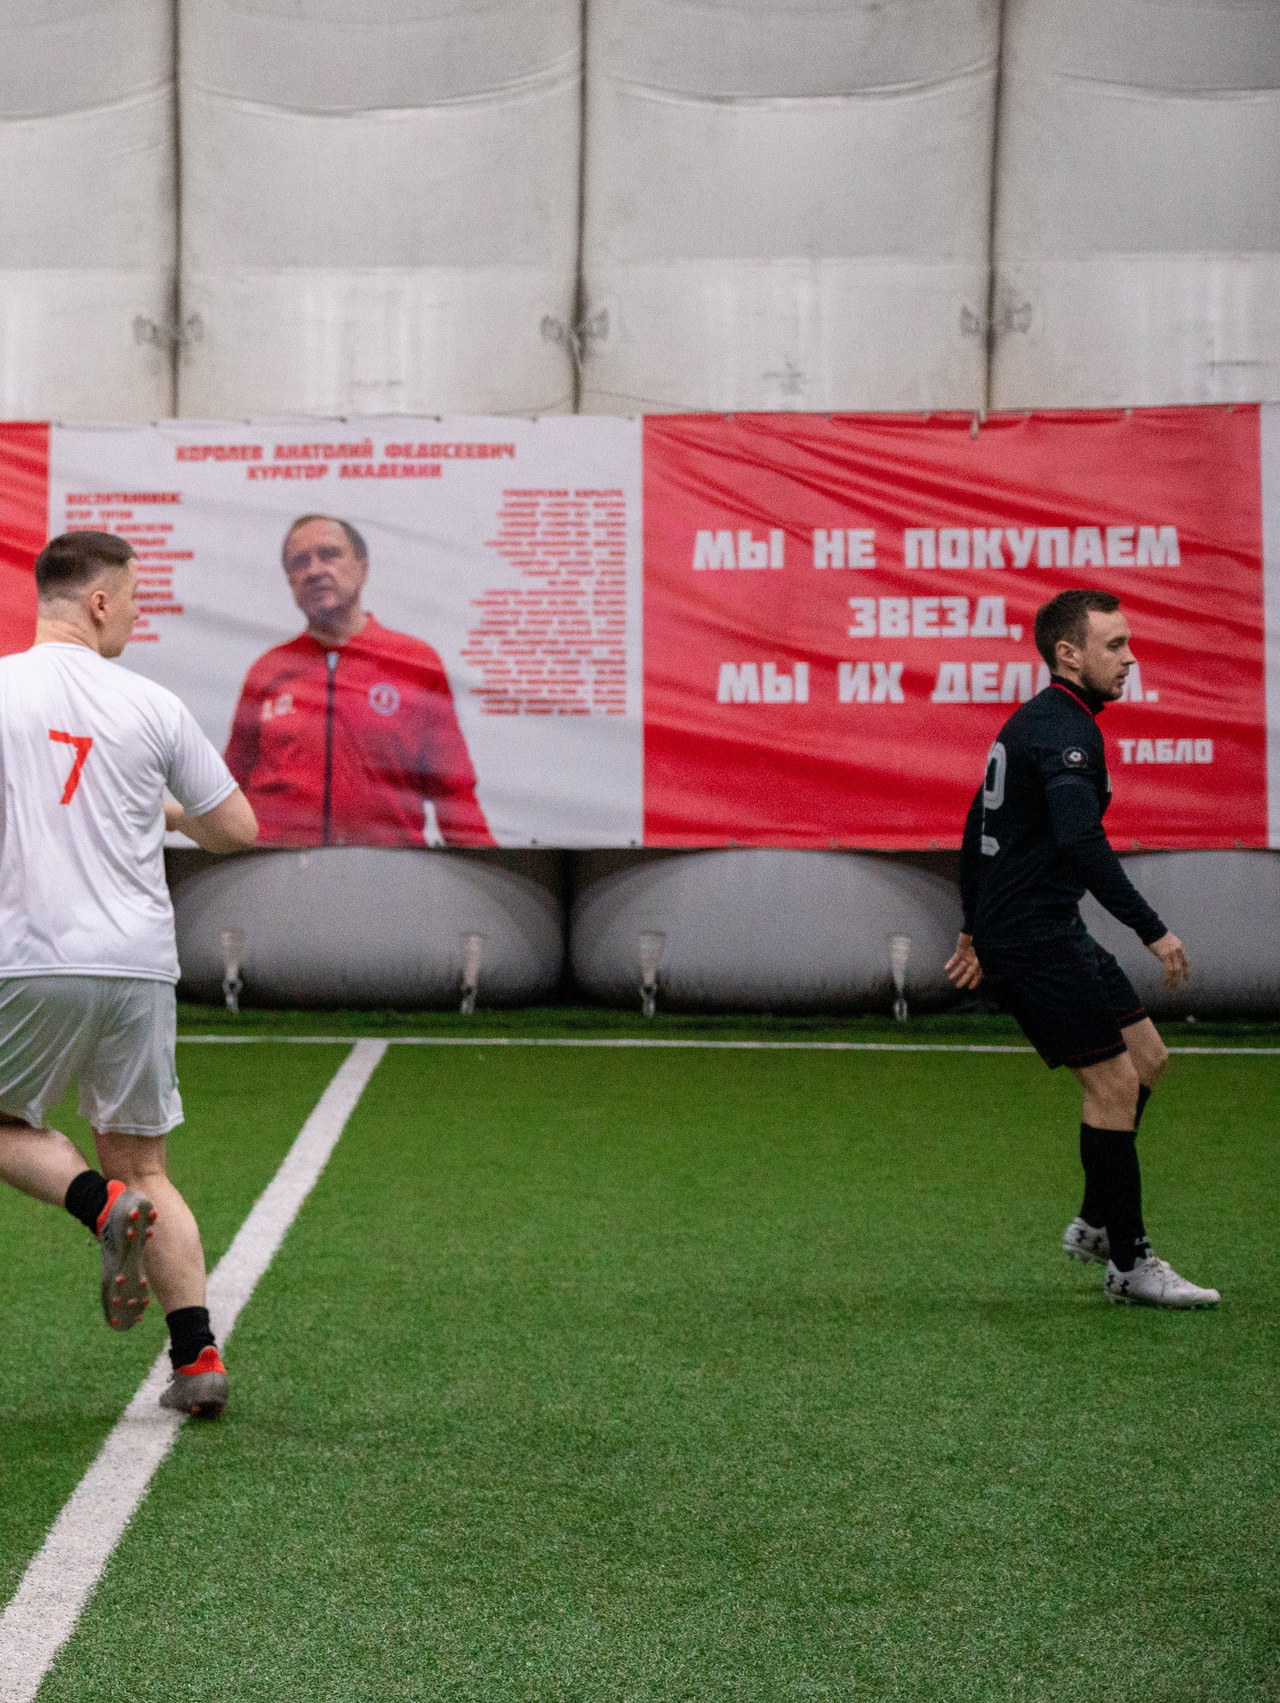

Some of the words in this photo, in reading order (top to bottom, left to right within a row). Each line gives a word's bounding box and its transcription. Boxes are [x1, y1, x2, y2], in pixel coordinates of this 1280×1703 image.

[176, 445, 263, 461] КОРОЛЕВ
[274, 437, 373, 460] АНАТОЛИЙ
[385, 443, 515, 459] ФЕДОСЕЕВИЧ
[247, 465, 329, 480] КУРАТОР
[338, 463, 442, 479] АКАДЕМИИ
[694, 529, 783, 570] МЫ
[814, 528, 876, 570] НЕ
[905, 525, 1181, 569] ПОКУПАЕМ
[848, 597, 1022, 641] ЗВЕЗД,
[718, 662, 809, 703] МЫ
[838, 661, 904, 703] ИХ
[48, 729, 92, 805] 7
[1119, 739, 1213, 764] ТАБЛО
